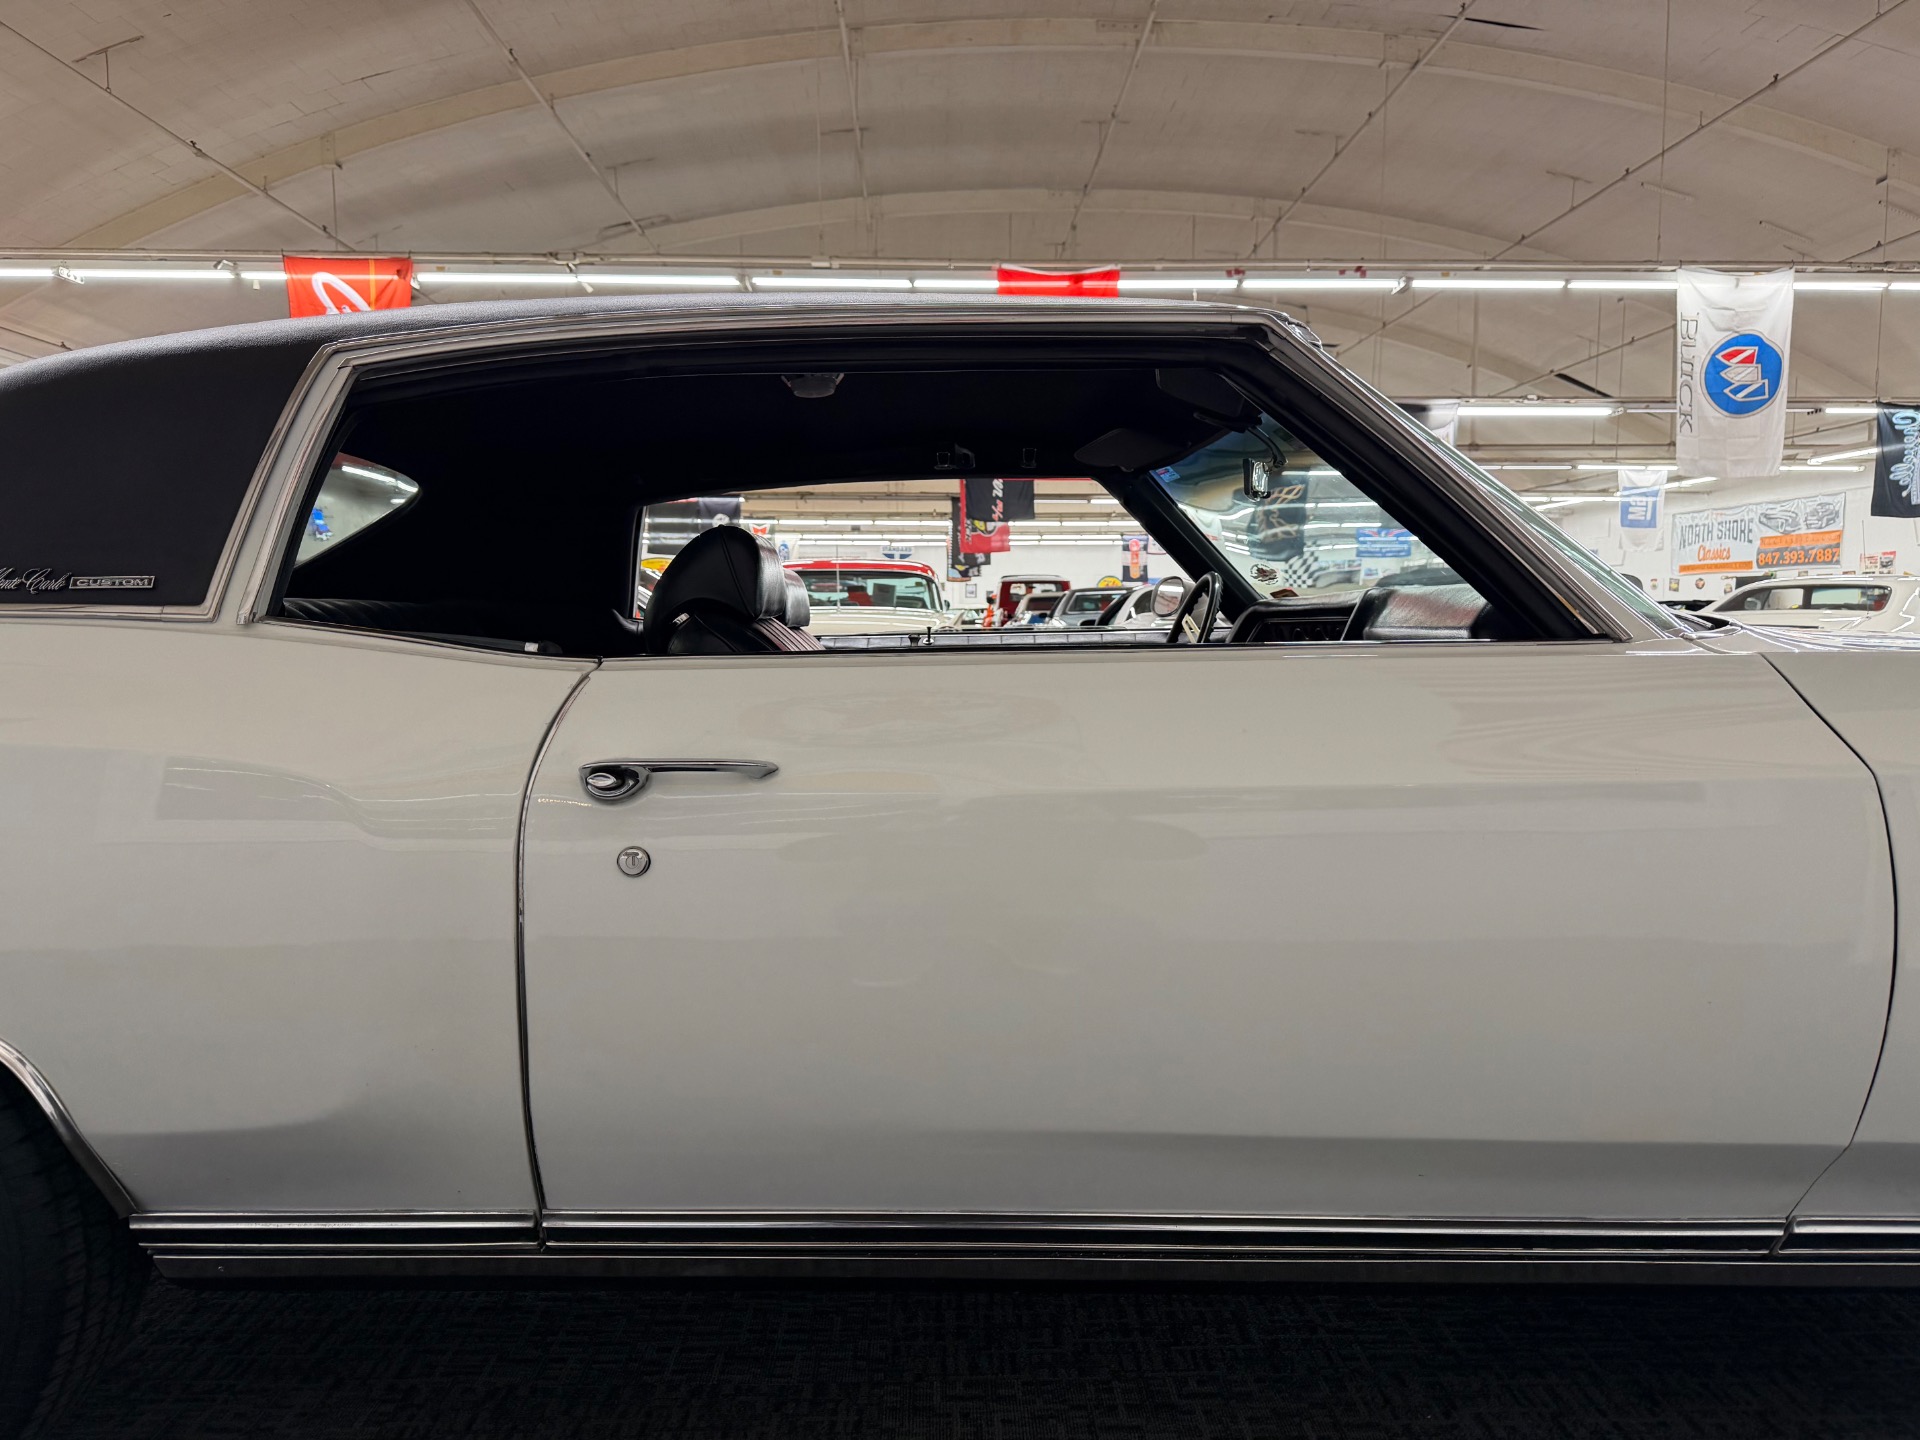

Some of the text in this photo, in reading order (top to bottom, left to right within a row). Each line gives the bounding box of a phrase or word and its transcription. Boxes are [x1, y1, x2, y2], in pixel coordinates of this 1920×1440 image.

[1679, 311, 1699, 433] BUICK
[1679, 522, 1714, 550] NORTH
[1716, 519, 1754, 544] SHORE
[1697, 543, 1731, 562] Classics
[1758, 548, 1840, 566] 847.393.7887
[22, 568, 72, 594] Carlo
[77, 578, 149, 587] CUSTOM
